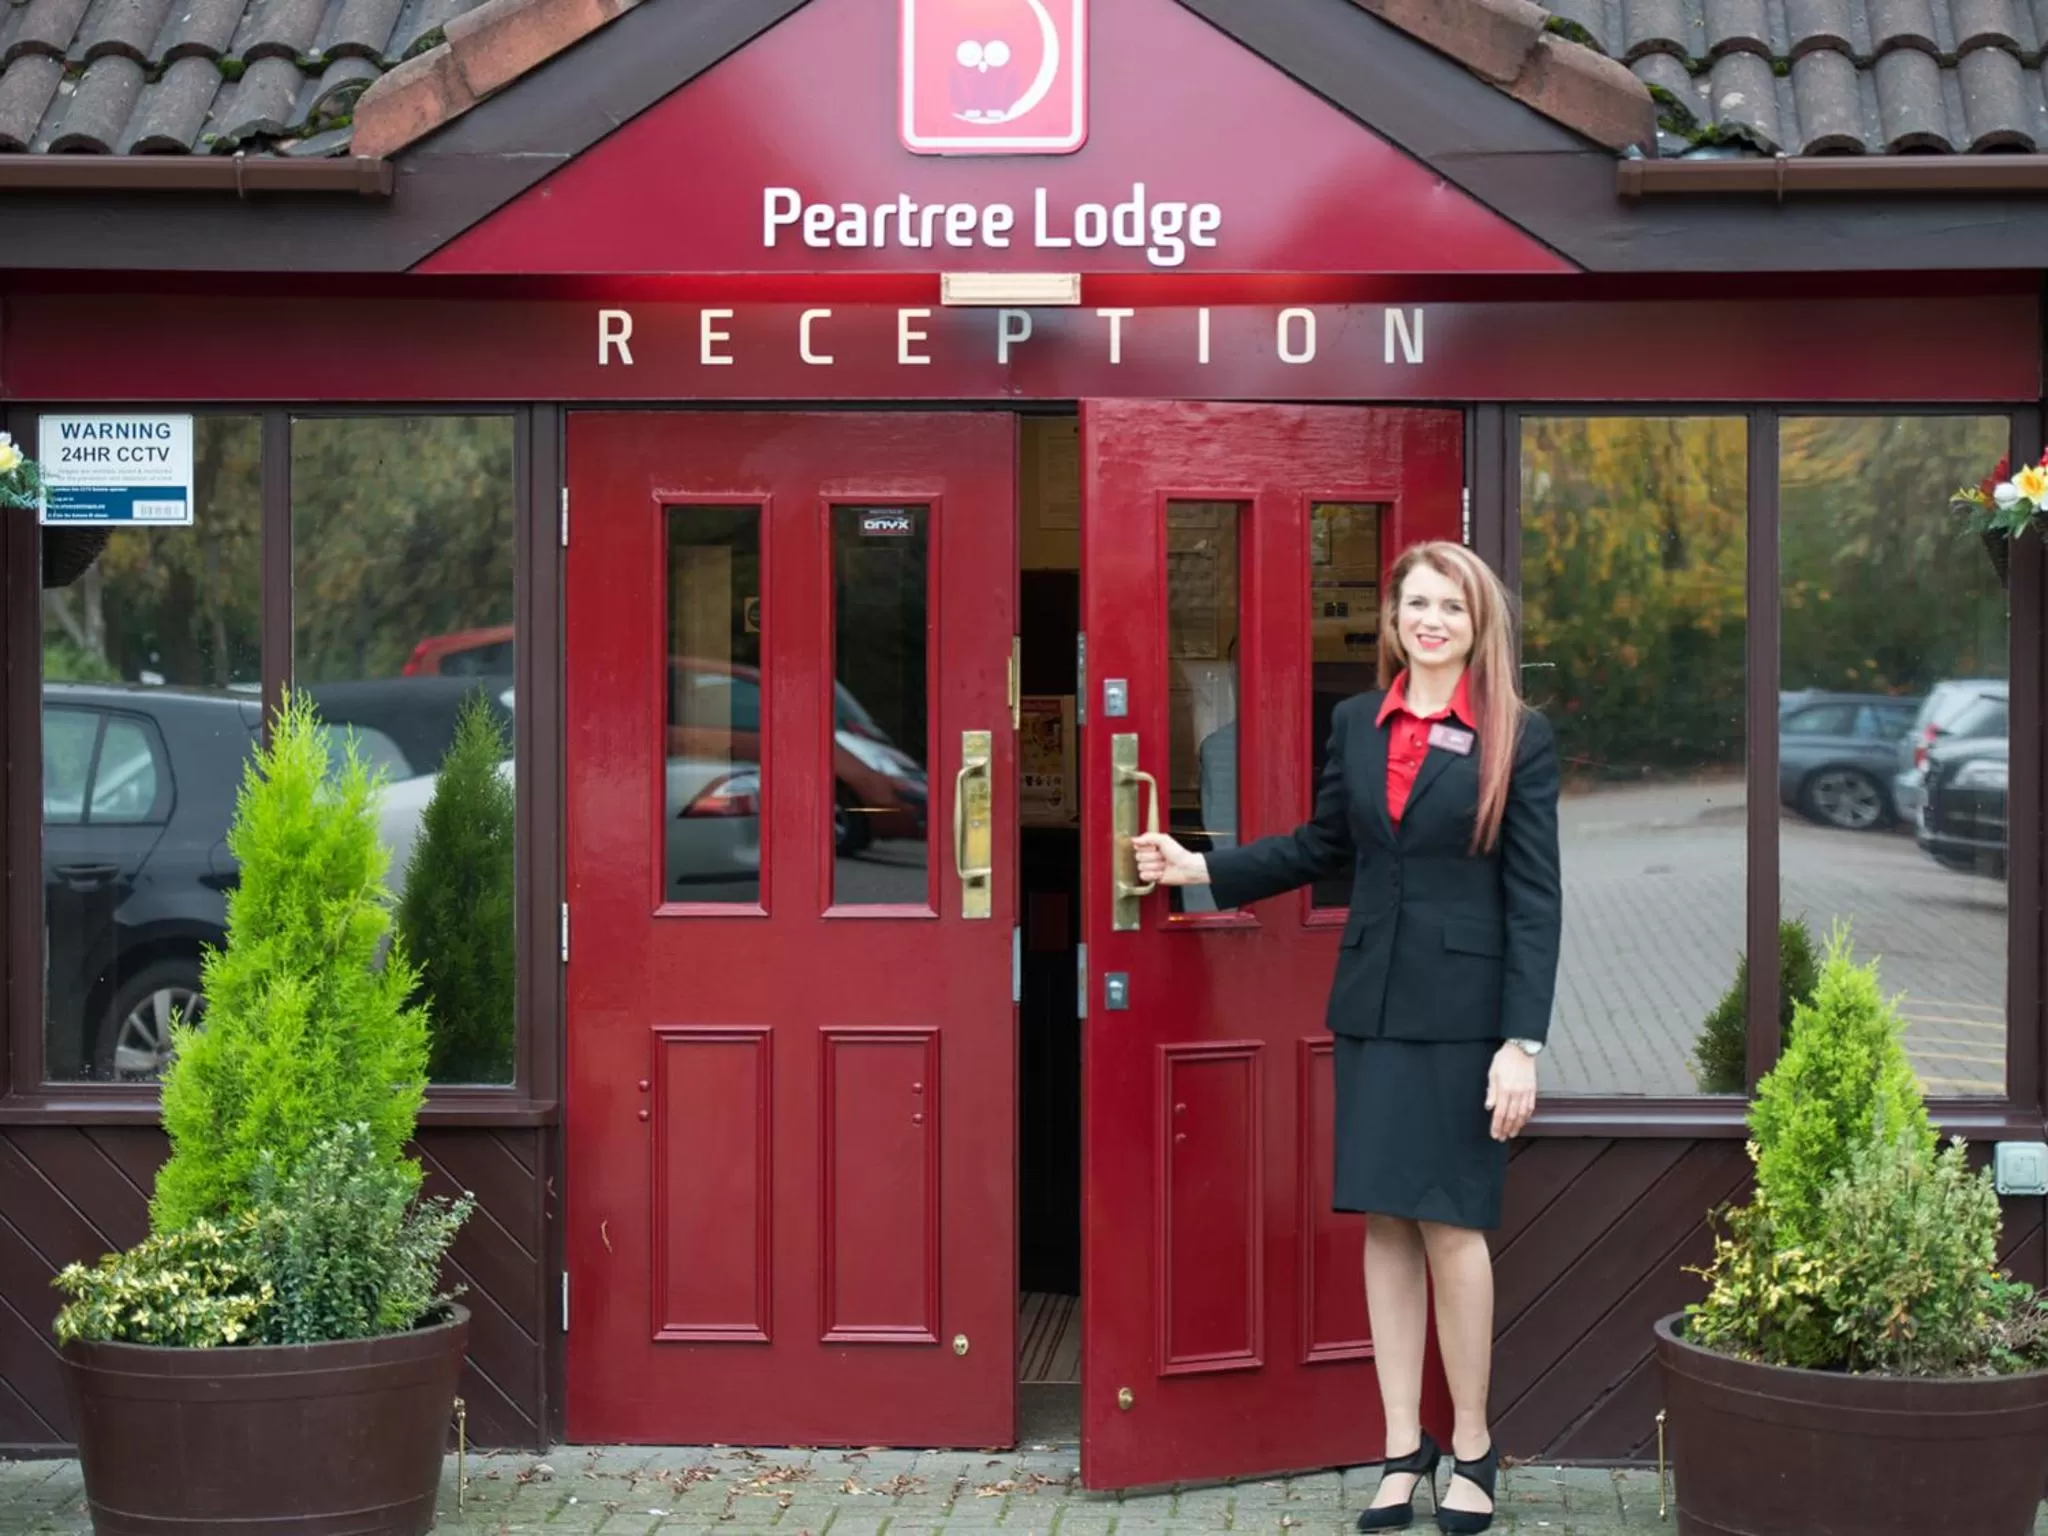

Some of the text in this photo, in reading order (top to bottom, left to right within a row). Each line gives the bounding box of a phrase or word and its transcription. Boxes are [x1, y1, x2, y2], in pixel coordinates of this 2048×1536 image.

[762, 182, 1221, 266] Peartree Lodge
[597, 307, 1426, 366] RECEPTION
[61, 422, 171, 440] WARNING
[61, 446, 170, 463] 24HR CCTV
